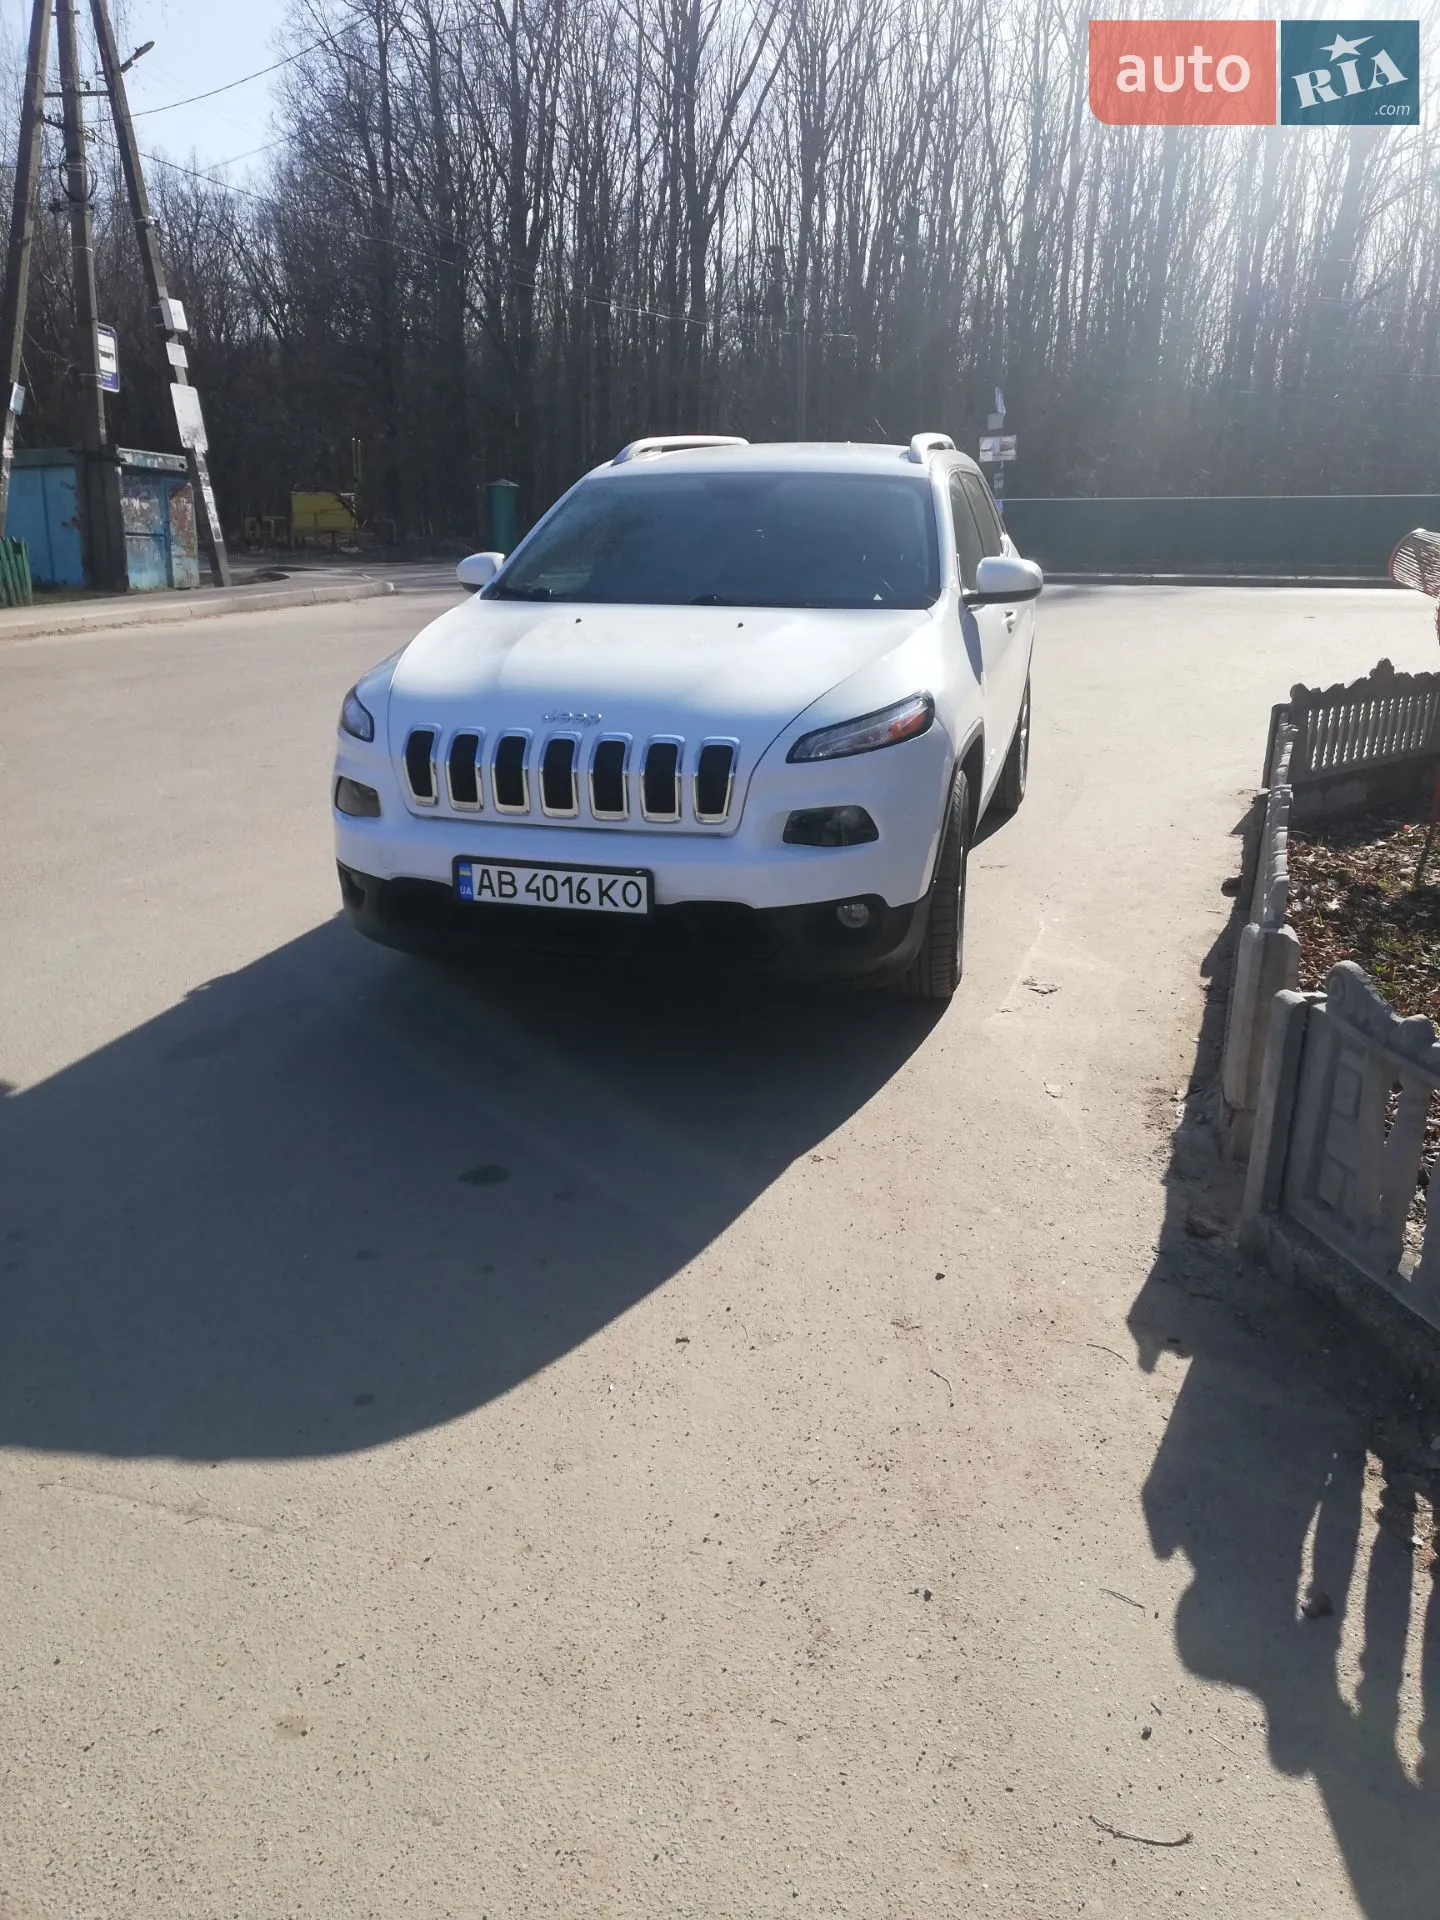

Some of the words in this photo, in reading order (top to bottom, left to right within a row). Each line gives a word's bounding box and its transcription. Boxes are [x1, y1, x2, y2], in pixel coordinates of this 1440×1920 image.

[459, 885, 473, 896] UA
[477, 868, 518, 899] AB
[524, 872, 592, 905] 4016
[597, 878, 642, 909] KO
